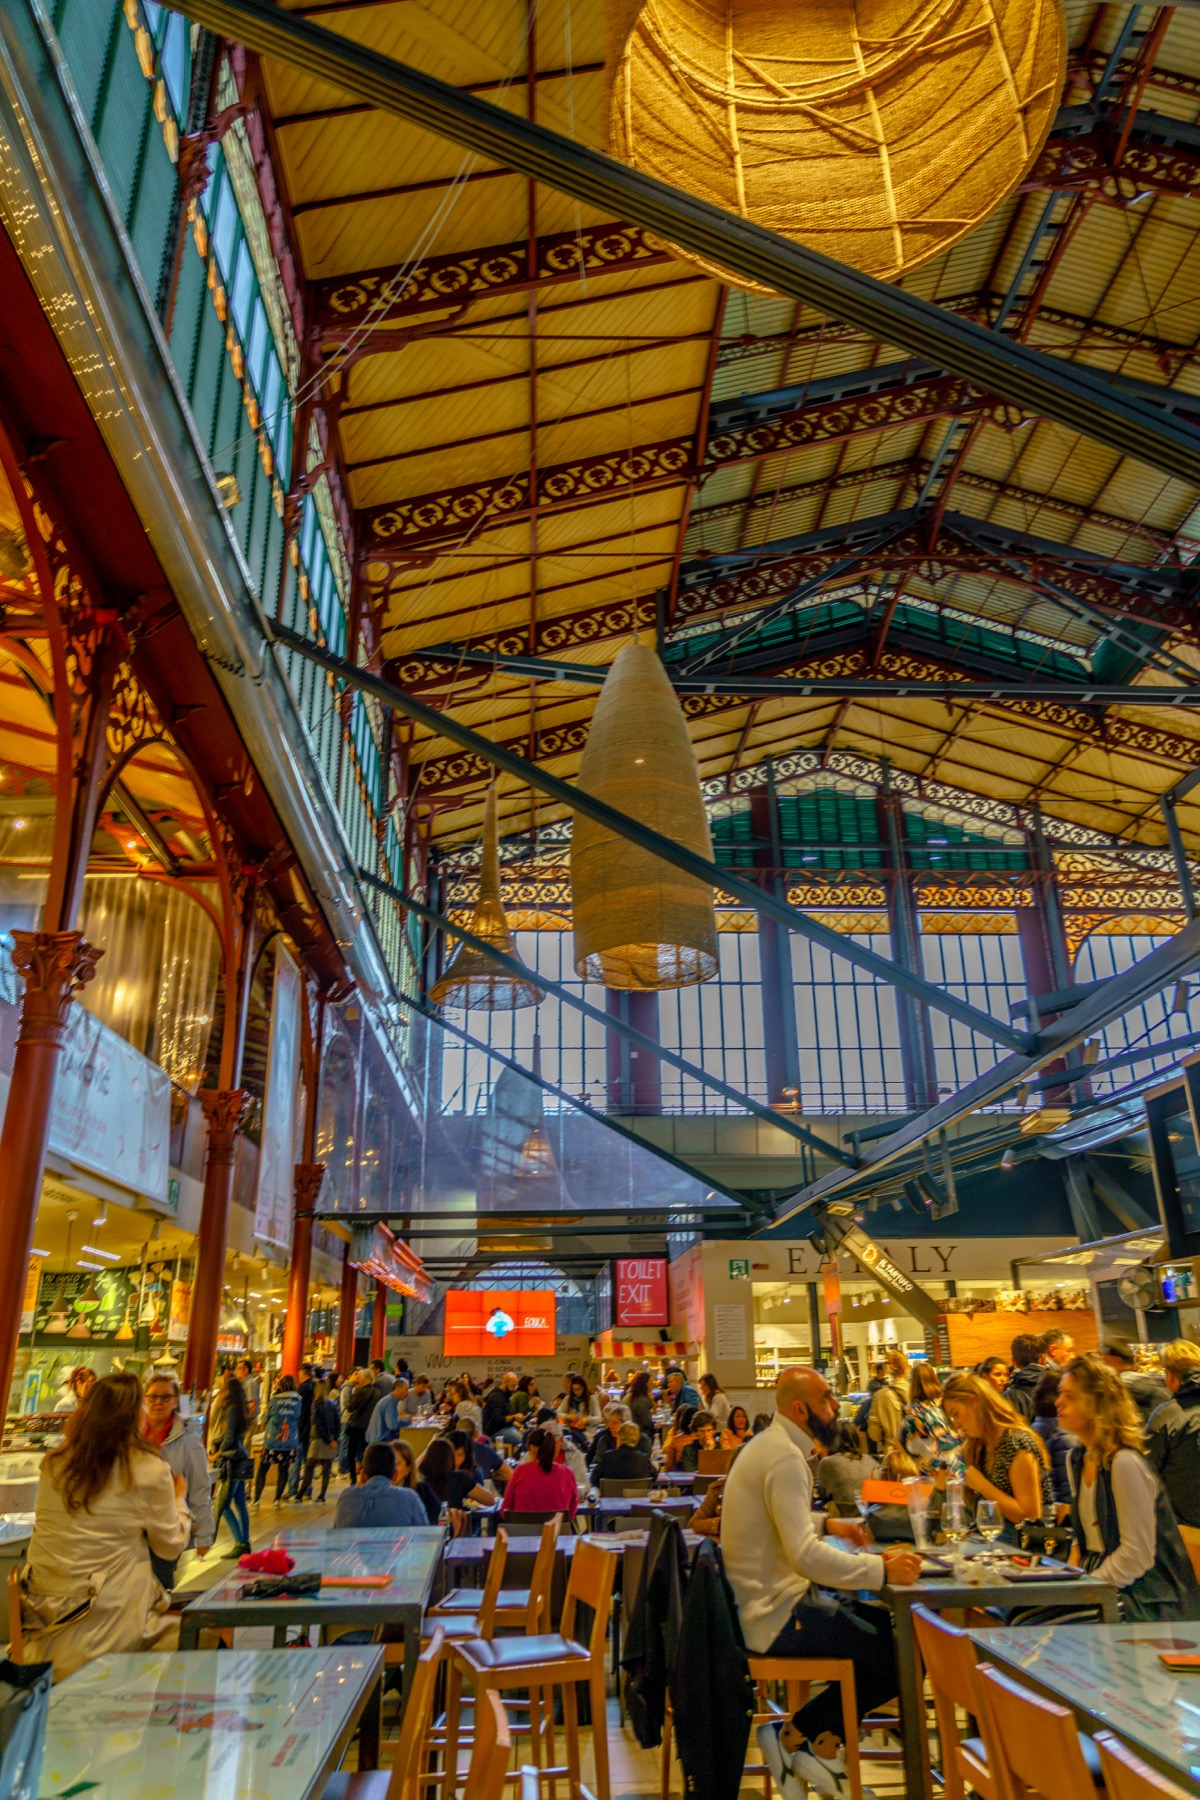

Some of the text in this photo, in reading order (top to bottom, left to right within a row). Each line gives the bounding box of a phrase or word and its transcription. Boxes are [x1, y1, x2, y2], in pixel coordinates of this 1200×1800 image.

[618, 1260, 664, 1279] TOILET
[885, 1264, 914, 1291] TARTUFO
[618, 1284, 652, 1304] EXIT
[425, 1352, 452, 1369] VINO
